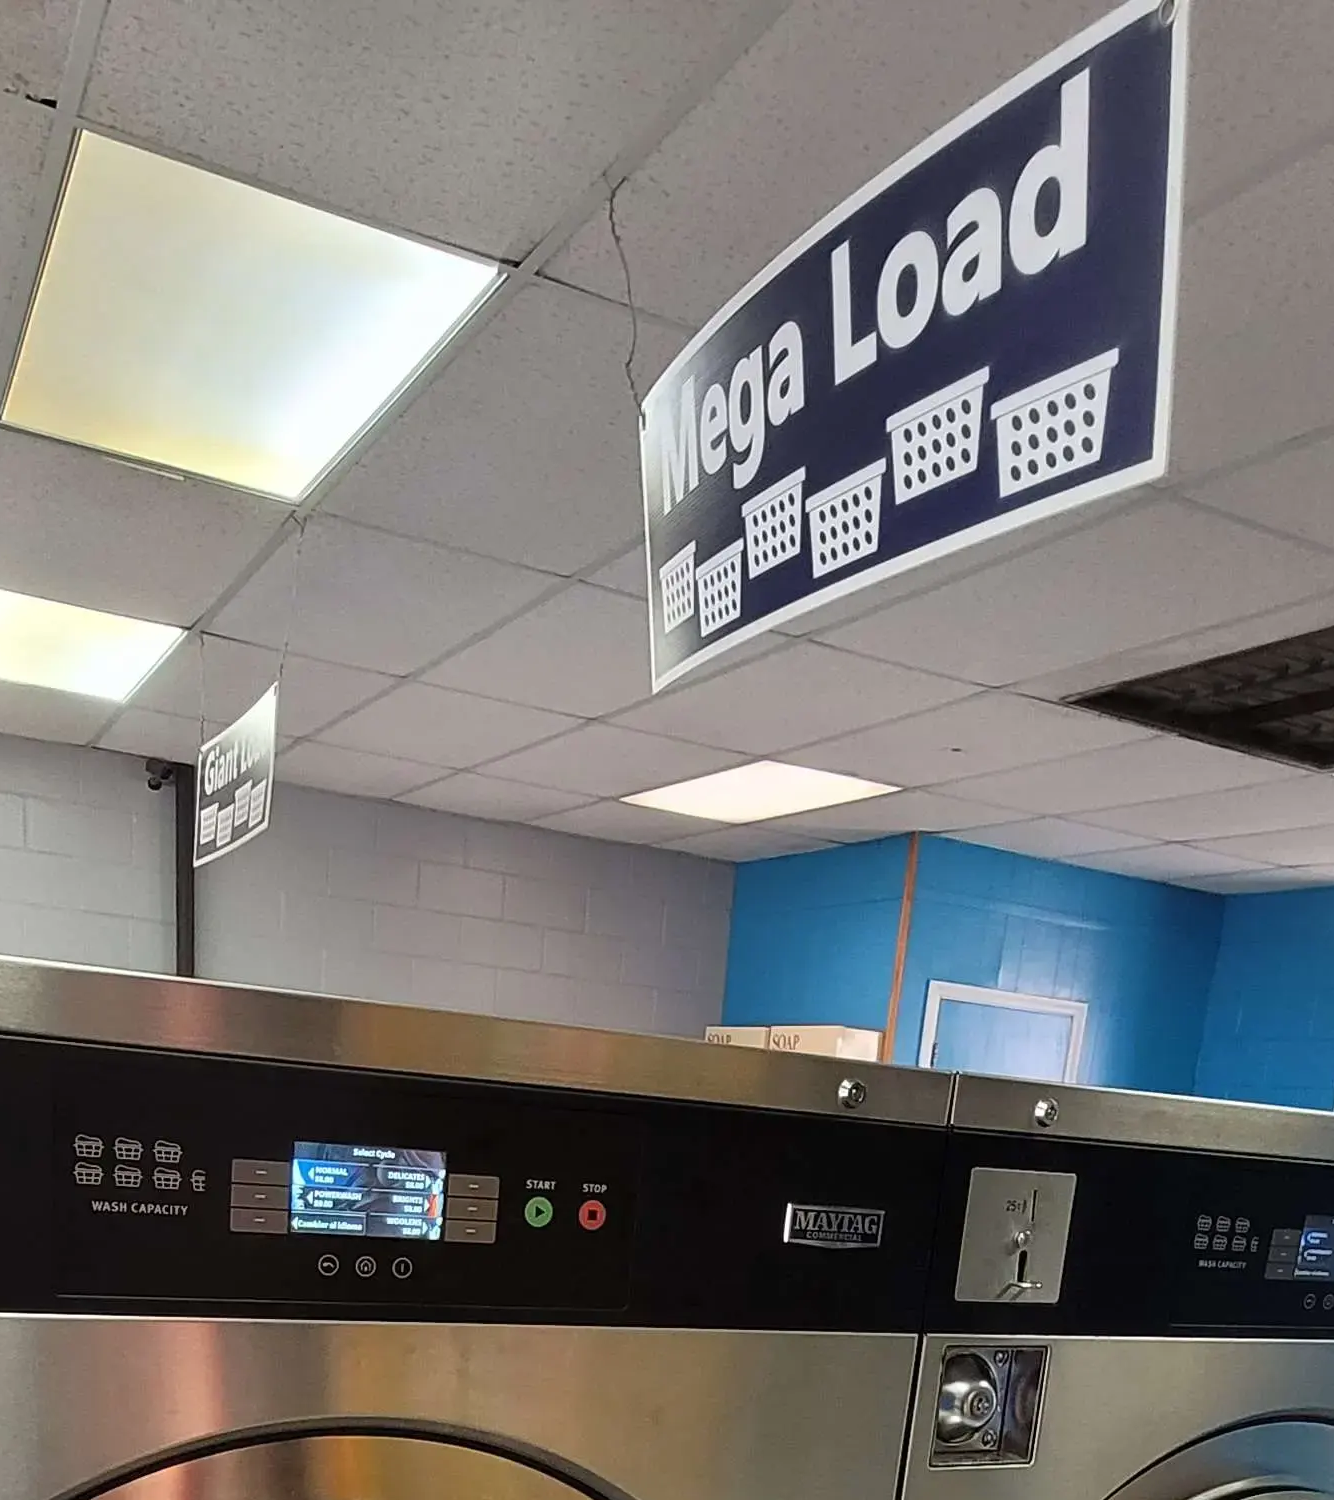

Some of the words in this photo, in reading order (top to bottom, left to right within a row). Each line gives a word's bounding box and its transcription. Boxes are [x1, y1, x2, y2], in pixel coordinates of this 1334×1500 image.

[657, 321, 805, 516] Mega
[830, 66, 1091, 386] Load
[204, 741, 238, 796] Giant
[772, 1033, 801, 1051] SOAP
[387, 1171, 425, 1181] DELICATES
[525, 1179, 556, 1191] START
[581, 1183, 608, 1193] STOP
[91, 1200, 127, 1212] WASH
[130, 1202, 188, 1216] CAPACITY
[793, 1210, 879, 1235] MAYTAG
[805, 1230, 863, 1242] COMMERCIAL
